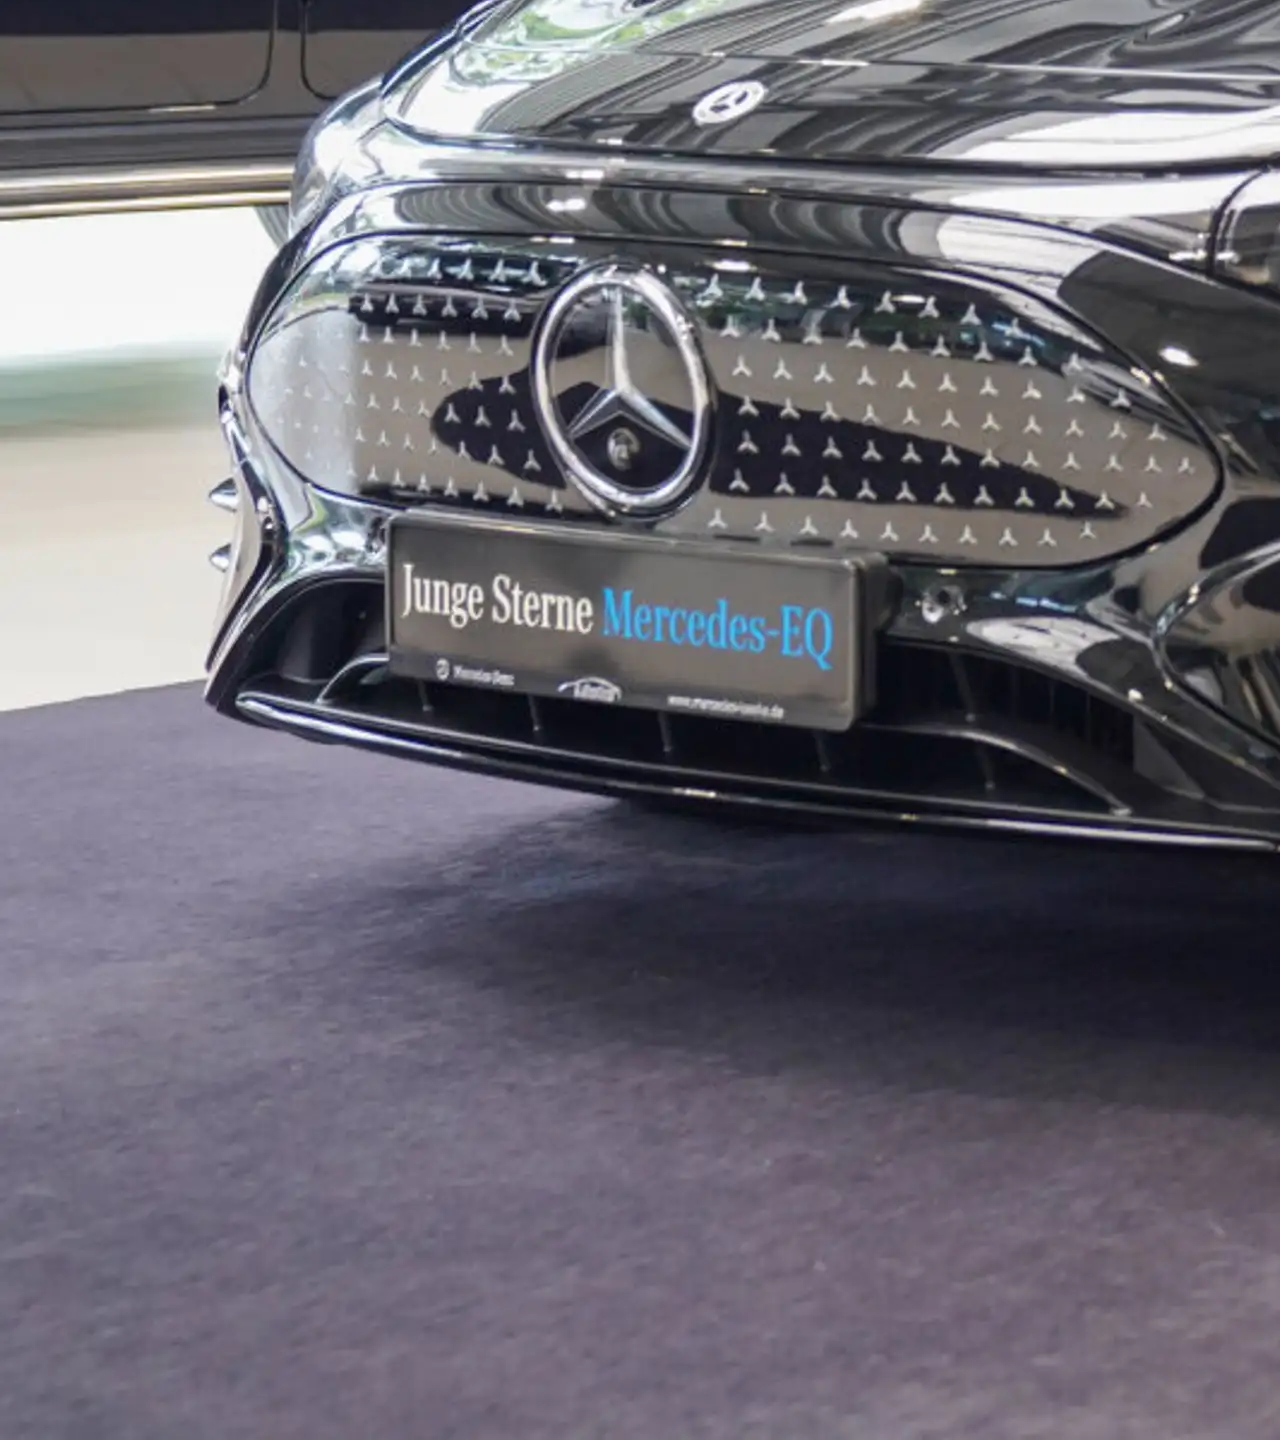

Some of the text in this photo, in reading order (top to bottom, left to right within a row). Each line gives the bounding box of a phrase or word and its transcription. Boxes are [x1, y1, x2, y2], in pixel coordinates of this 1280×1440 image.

[402, 564, 833, 670] Junge Sterne Mercedes-EQ
